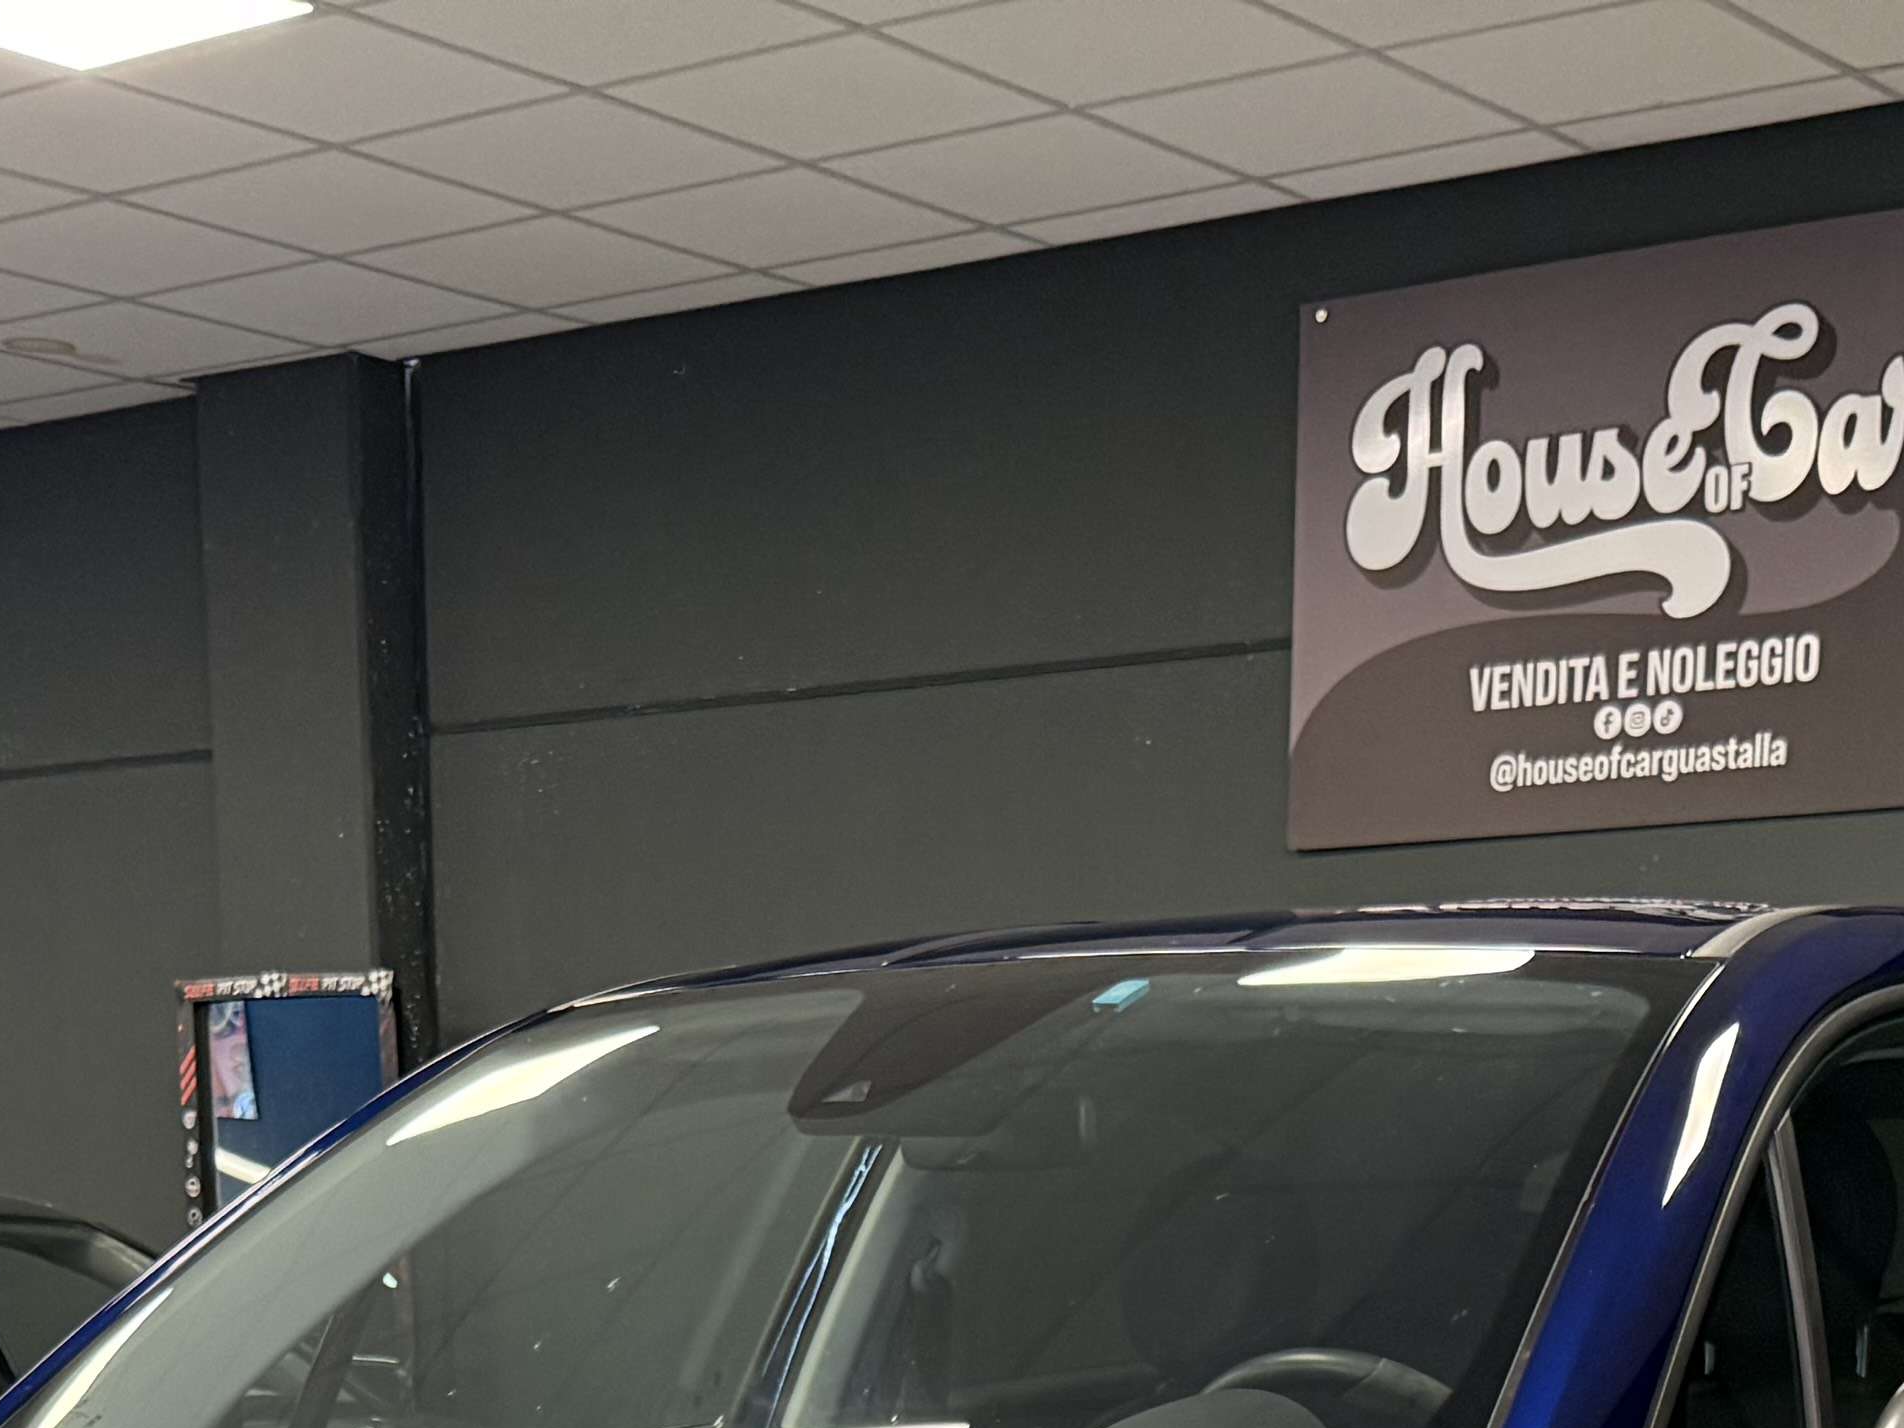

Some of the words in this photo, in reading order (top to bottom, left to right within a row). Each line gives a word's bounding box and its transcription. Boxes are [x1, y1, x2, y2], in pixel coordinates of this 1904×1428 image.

[1346, 344, 1730, 618] House
[1705, 461, 1752, 514] OF
[1470, 655, 1609, 712] VENDITA
[1617, 652, 1641, 699] E
[1646, 633, 1820, 696] NOLEGGIO
[1490, 731, 1788, 792] @houseofcarguastalla
